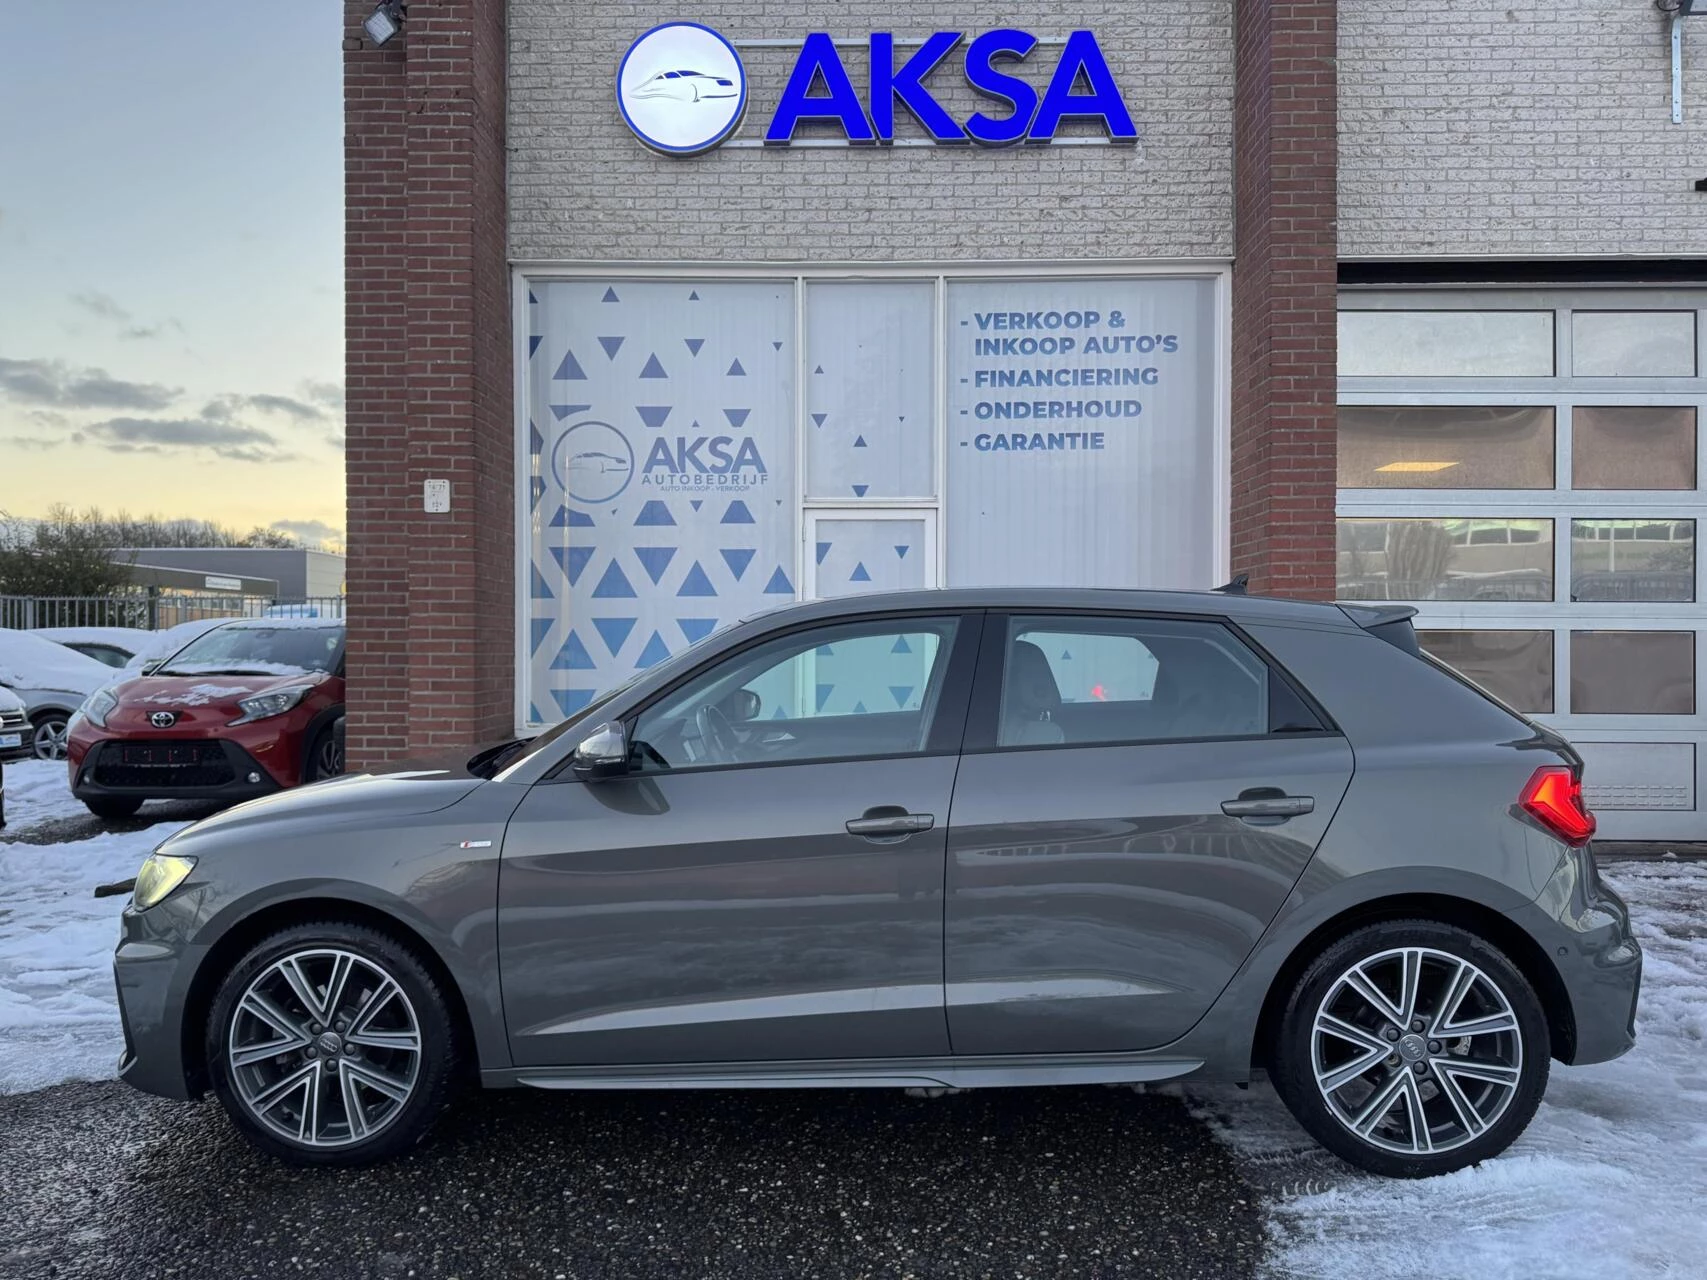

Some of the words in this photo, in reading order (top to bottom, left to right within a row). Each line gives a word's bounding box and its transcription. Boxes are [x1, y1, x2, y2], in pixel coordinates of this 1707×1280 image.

[763, 28, 1138, 144] AKSA
[974, 310, 1101, 330] VERKOOP
[1107, 310, 1126, 329] &
[975, 337, 1076, 356] INKOOP
[1083, 334, 1179, 354] AUTO'S
[974, 367, 1159, 388] FINANCIERING
[974, 399, 1142, 420] ONDERHOUD
[974, 432, 1105, 451] GARANTIE
[642, 436, 768, 474] AKSA
[641, 474, 769, 485] AUTOBEDRIJF
